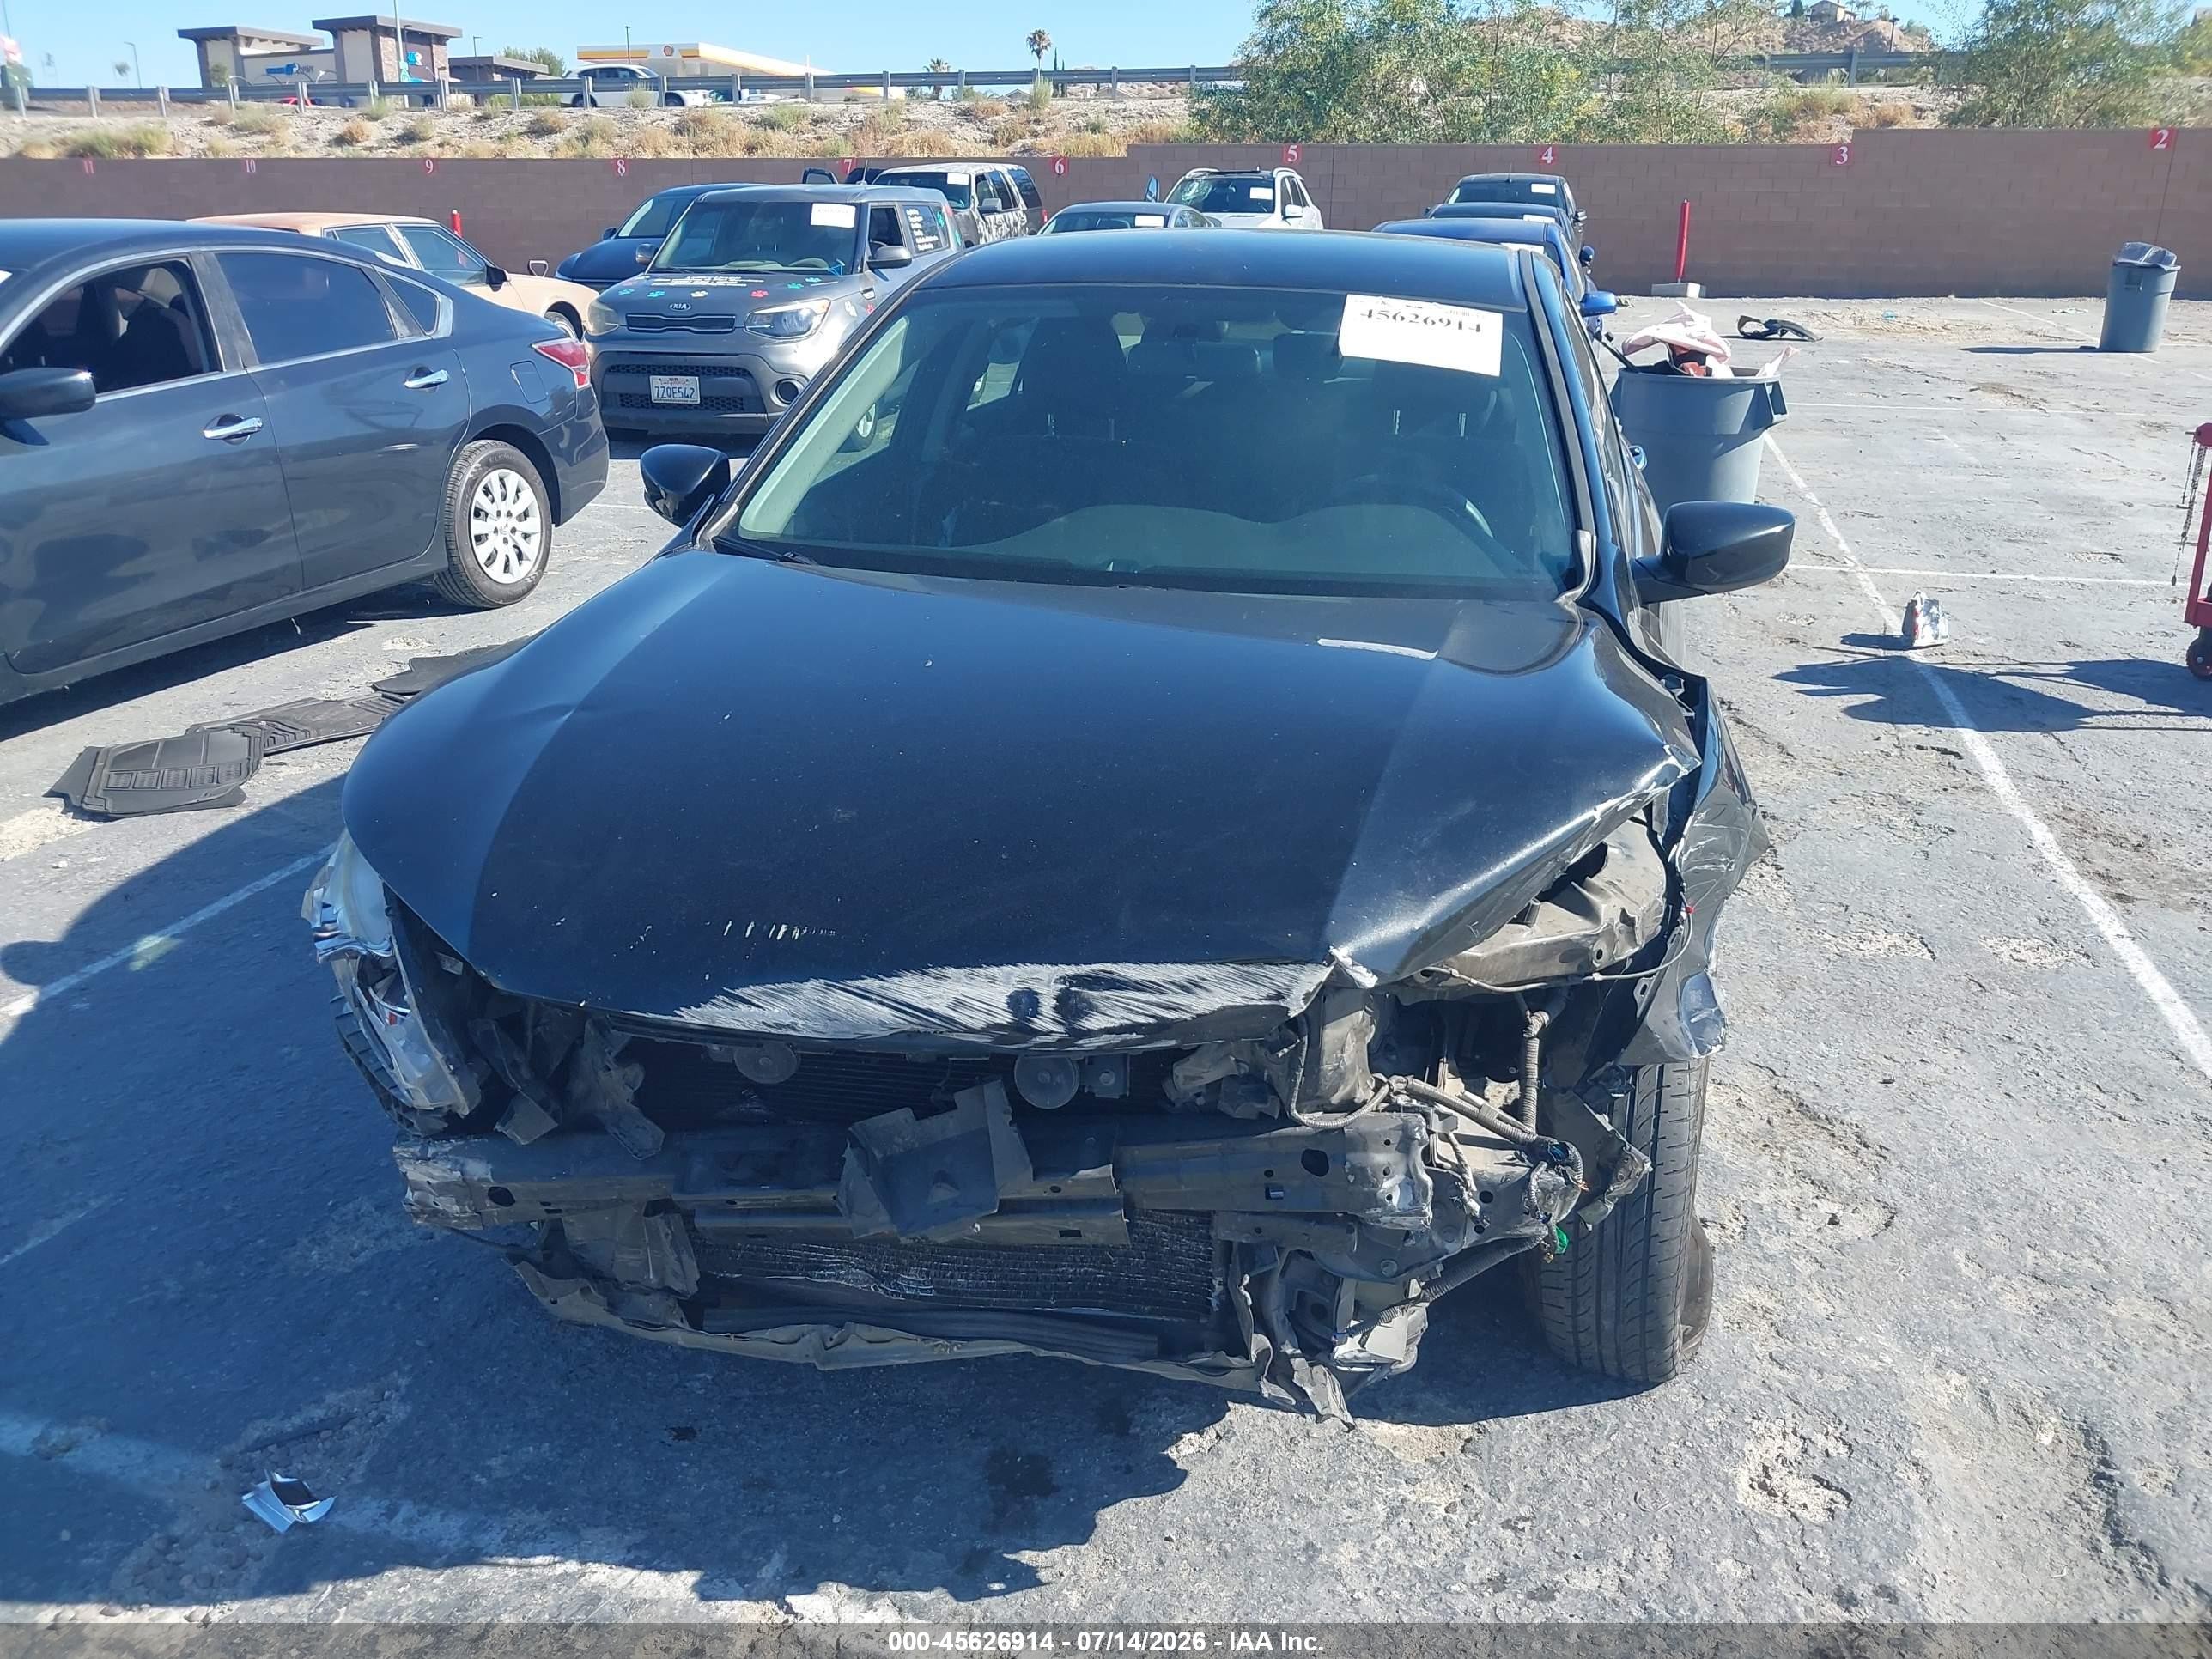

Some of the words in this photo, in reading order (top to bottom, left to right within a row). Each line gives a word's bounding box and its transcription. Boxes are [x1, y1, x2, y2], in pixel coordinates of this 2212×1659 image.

[2153, 129, 2169, 149] 2
[1287, 144, 1298, 162] 5
[1541, 145, 1553, 164] 4
[1835, 145, 1849, 165] 3
[245, 159, 256, 173] 10
[424, 159, 434, 173] 9
[617, 159, 626, 175] 8
[843, 158, 853, 174] 7
[1054, 158, 1065, 174] 6
[1360, 308, 1482, 333] 45626914
